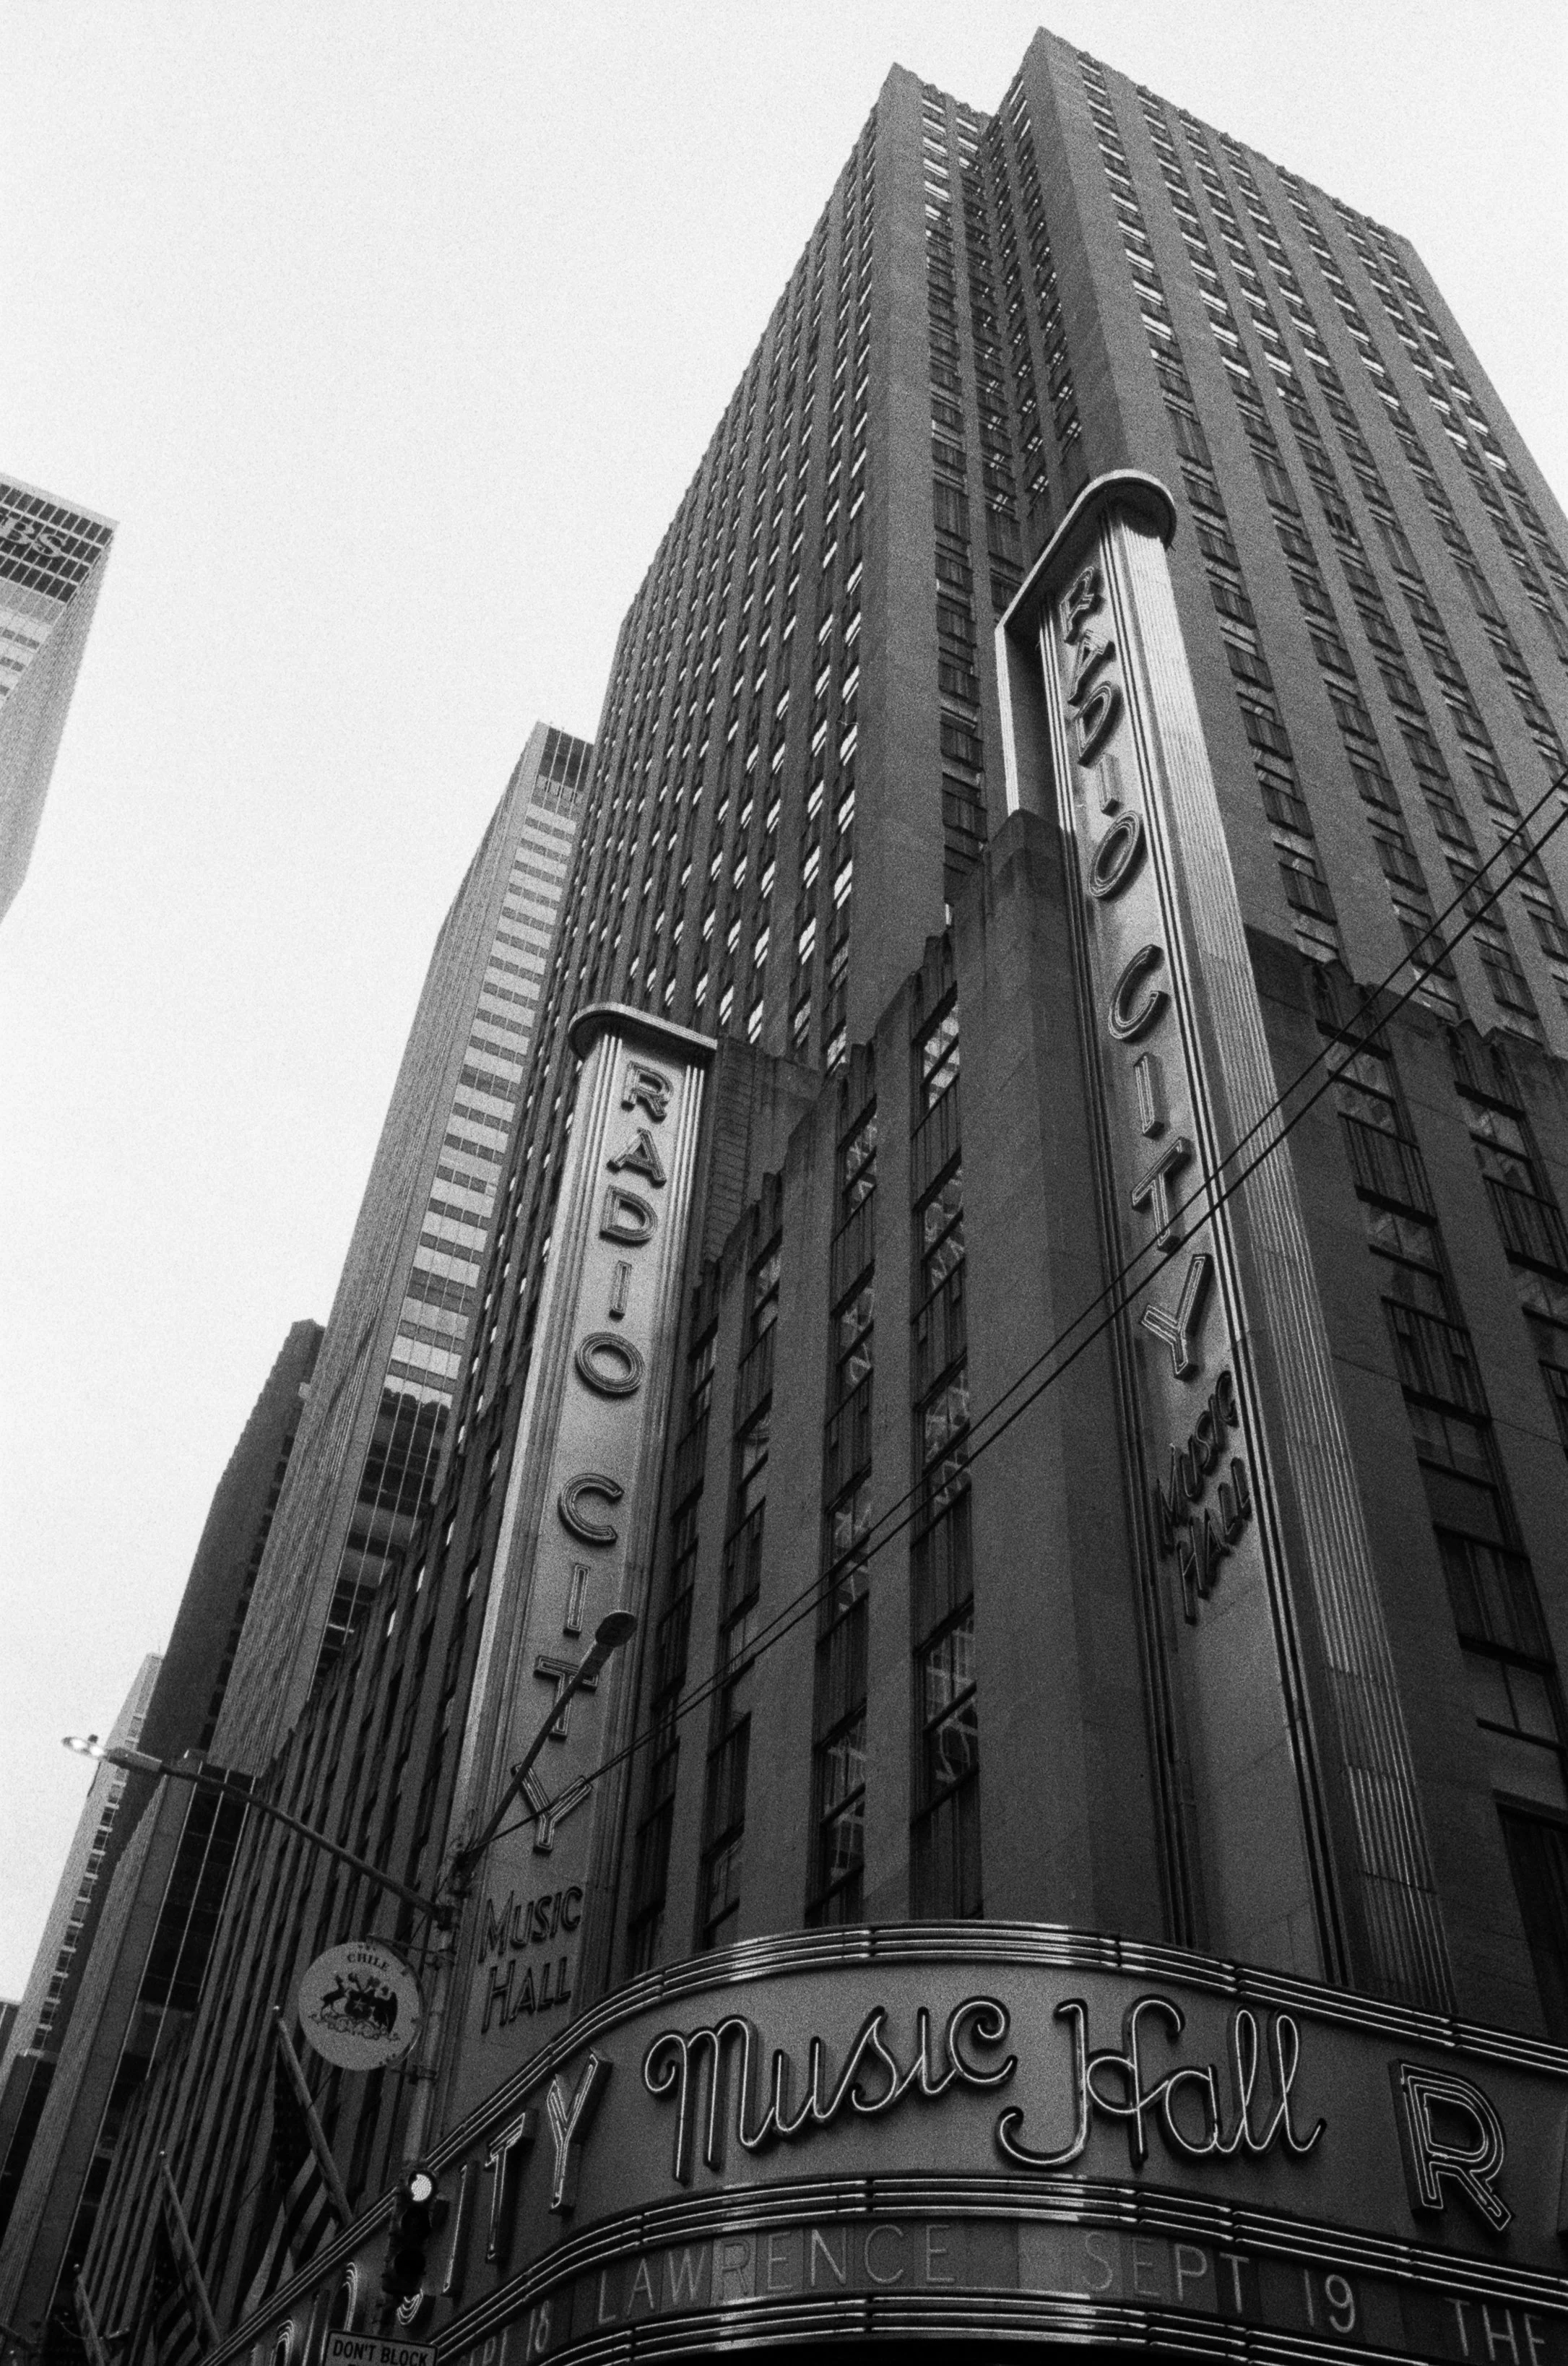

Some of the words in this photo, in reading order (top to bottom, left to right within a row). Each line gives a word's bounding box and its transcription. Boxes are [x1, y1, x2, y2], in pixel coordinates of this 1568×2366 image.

[1059, 566, 1144, 898] RADIO
[1107, 944, 1212, 1381] CITY
[576, 1061, 674, 1399] RADIO
[1154, 1370, 1239, 1555] MUSIC
[1177, 1456, 1253, 1625] HALL
[510, 1472, 623, 1855] CITY
[346, 1953, 390, 1972] CHILE
[477, 1886, 584, 1964] MUSIC
[481, 1956, 572, 2035] HALL
[644, 1995, 1017, 2185] Music
[996, 1995, 1327, 2164] Hall
[397, 2049, 612, 2324] ITY
[333, 2339, 376, 2362] DON'T
[381, 2348, 428, 2366] BLOCK
[526, 2300, 551, 2361] 18
[597, 2223, 956, 2323] LAWRENCE
[1085, 2231, 1250, 2313] SEPT
[1302, 2268, 1356, 2333] 19
